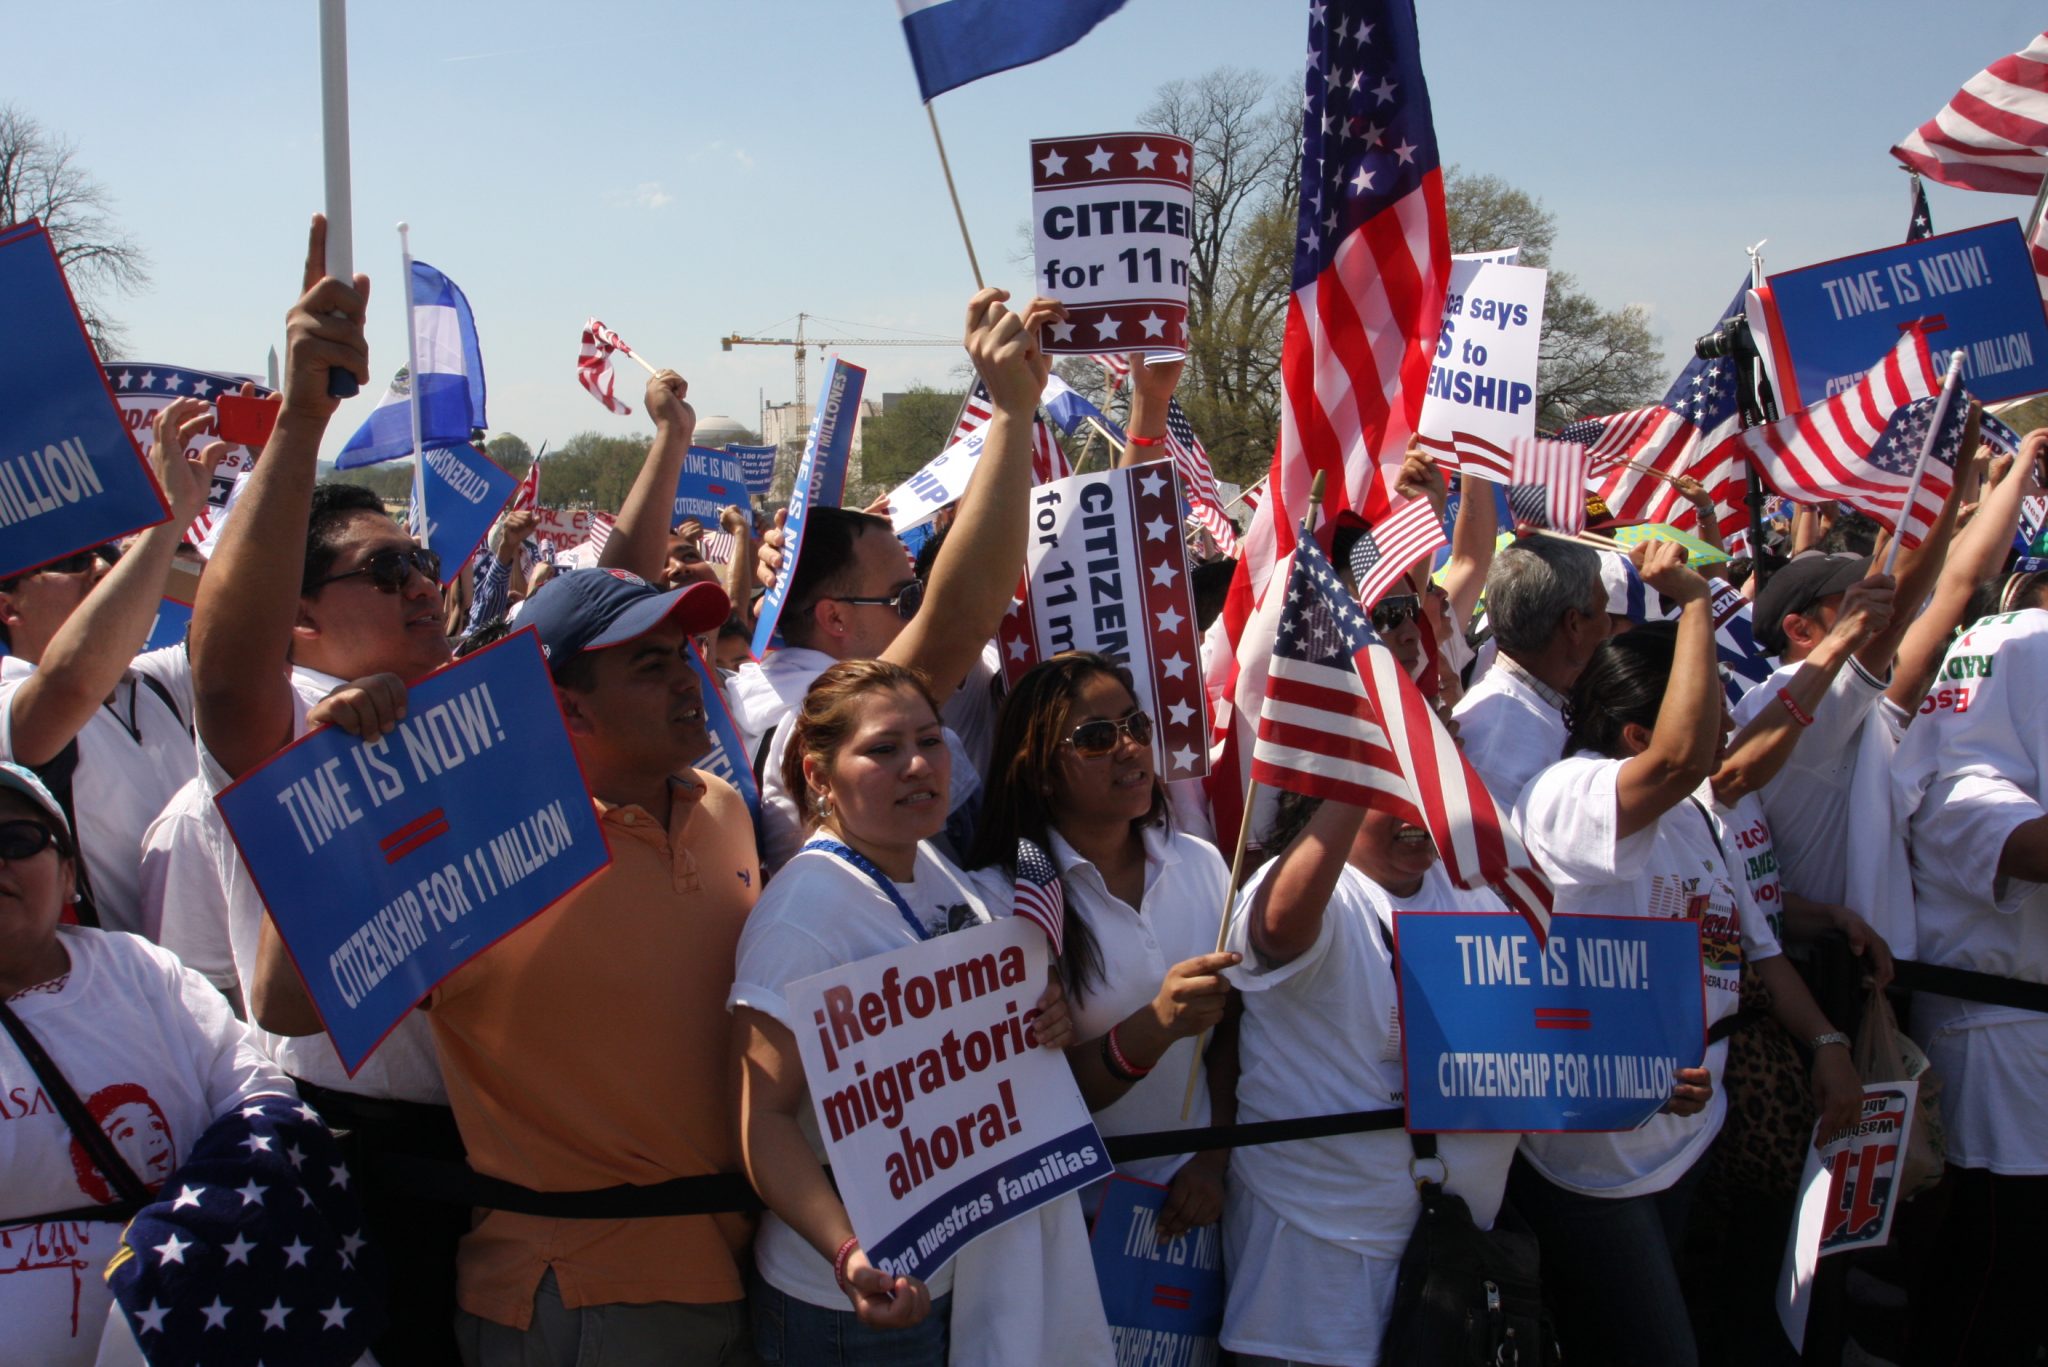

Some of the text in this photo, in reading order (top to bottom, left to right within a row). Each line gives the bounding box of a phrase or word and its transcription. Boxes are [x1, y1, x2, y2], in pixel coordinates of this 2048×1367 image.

[1043, 259, 1104, 289] for
[1118, 247, 1162, 283] 11
[1822, 246, 1992, 320] TIME IS NOW!
[1470, 298, 1528, 330] says
[1462, 338, 1487, 366] to
[1973, 332, 2033, 377] MILLION
[819, 372, 847, 447] MILLONES
[683, 454, 708, 476] TIME
[710, 458, 720, 478] IS
[801, 412, 822, 481] TIME
[674, 497, 713, 517] CITIZENSHIP
[789, 489, 804, 520] IS
[1037, 490, 1062, 549] for
[1043, 560, 1077, 607] 11
[277, 682, 506, 855] TIME IS NOW!
[328, 799, 573, 1010] CITIZENSHIP FOR 11 MILLION
[1455, 935, 1649, 990] TIME IS NOW!
[814, 946, 1026, 1073] ¡Reforma
[1438, 1052, 1551, 1099] CITIZENSHIP
[1554, 1053, 1591, 1099] FOR
[1593, 1055, 1611, 1099] 11
[885, 1079, 1023, 1200] ahora!
[878, 1145, 1098, 1281] Para nuestras familias
